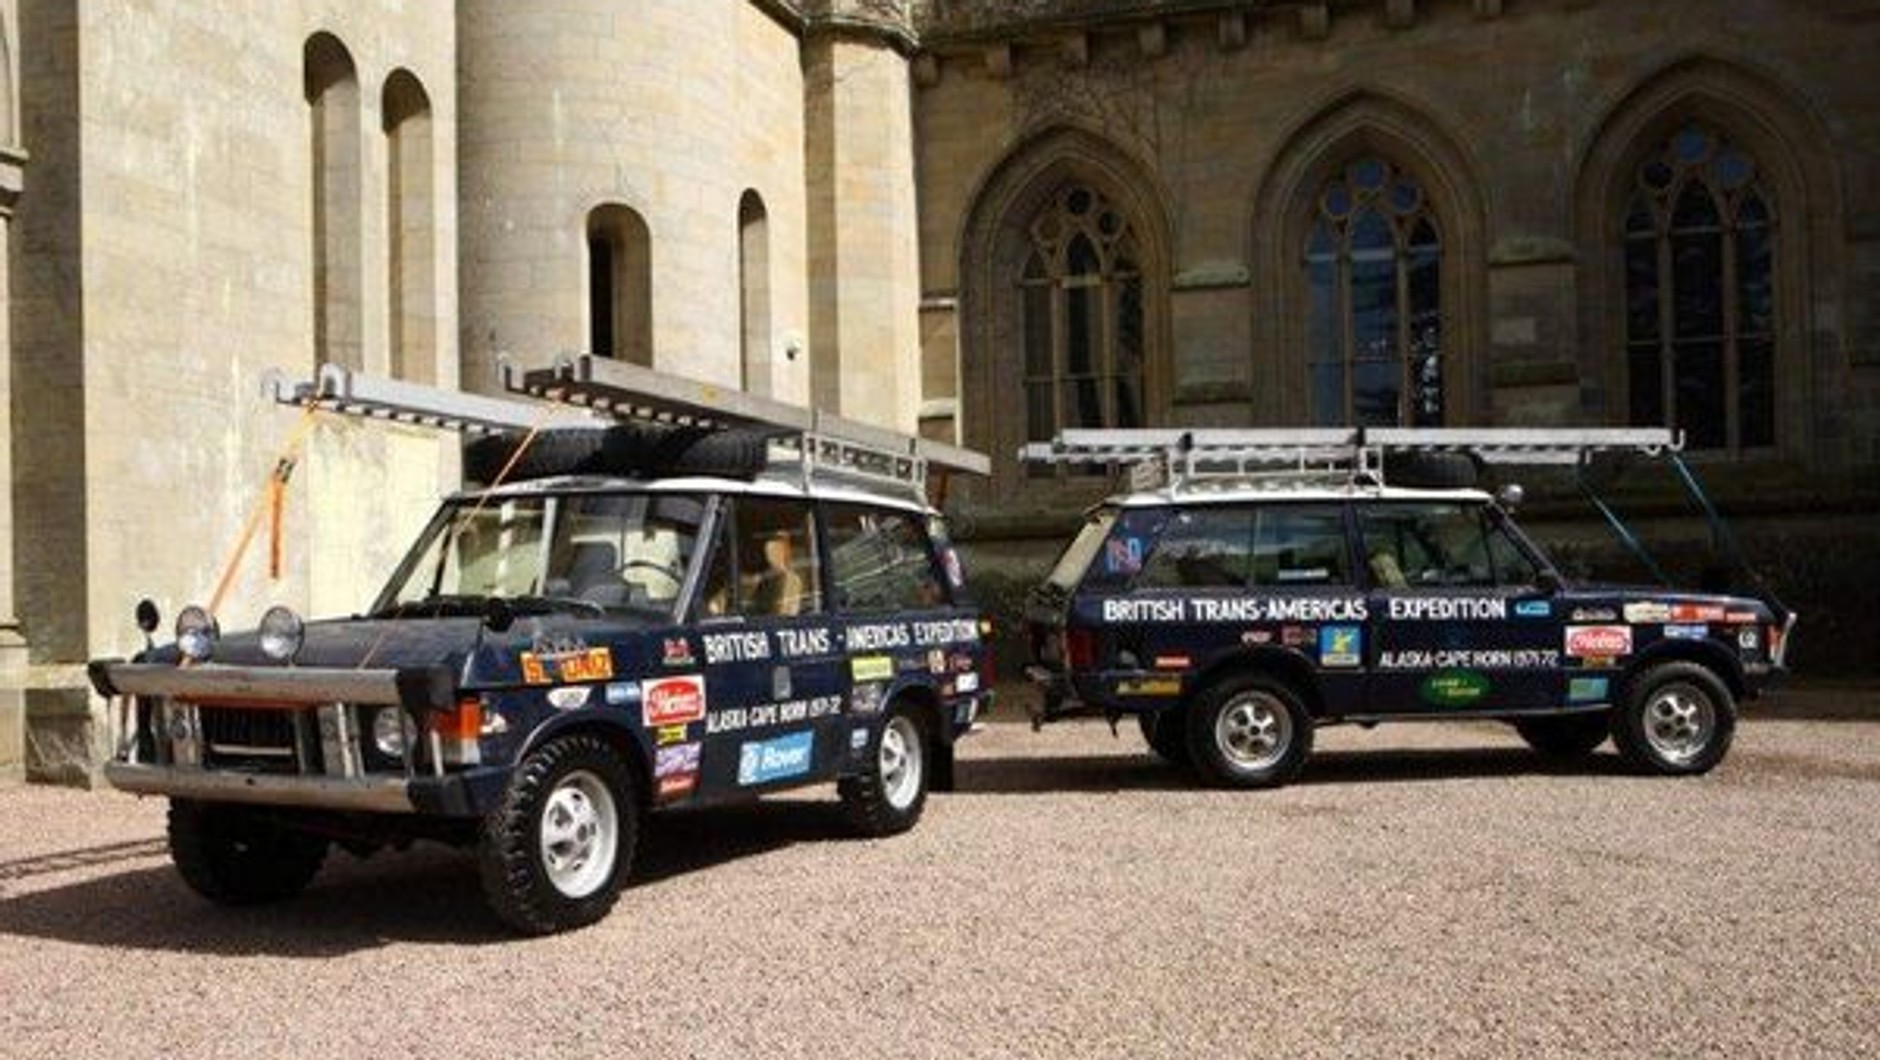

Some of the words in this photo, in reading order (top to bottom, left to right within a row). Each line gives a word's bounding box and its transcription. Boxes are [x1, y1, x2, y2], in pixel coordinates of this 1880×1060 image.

[1103, 598, 1184, 621] BRITISH
[1193, 597, 1368, 621] TRANS-AMERICAS
[1389, 598, 1506, 620] EXPEDITION
[703, 630, 770, 664] BRITISH
[775, 626, 830, 657] TRANS
[912, 618, 979, 645] EXPEDITION
[1473, 650, 1512, 668] HORN
[761, 746, 806, 771] Rover
